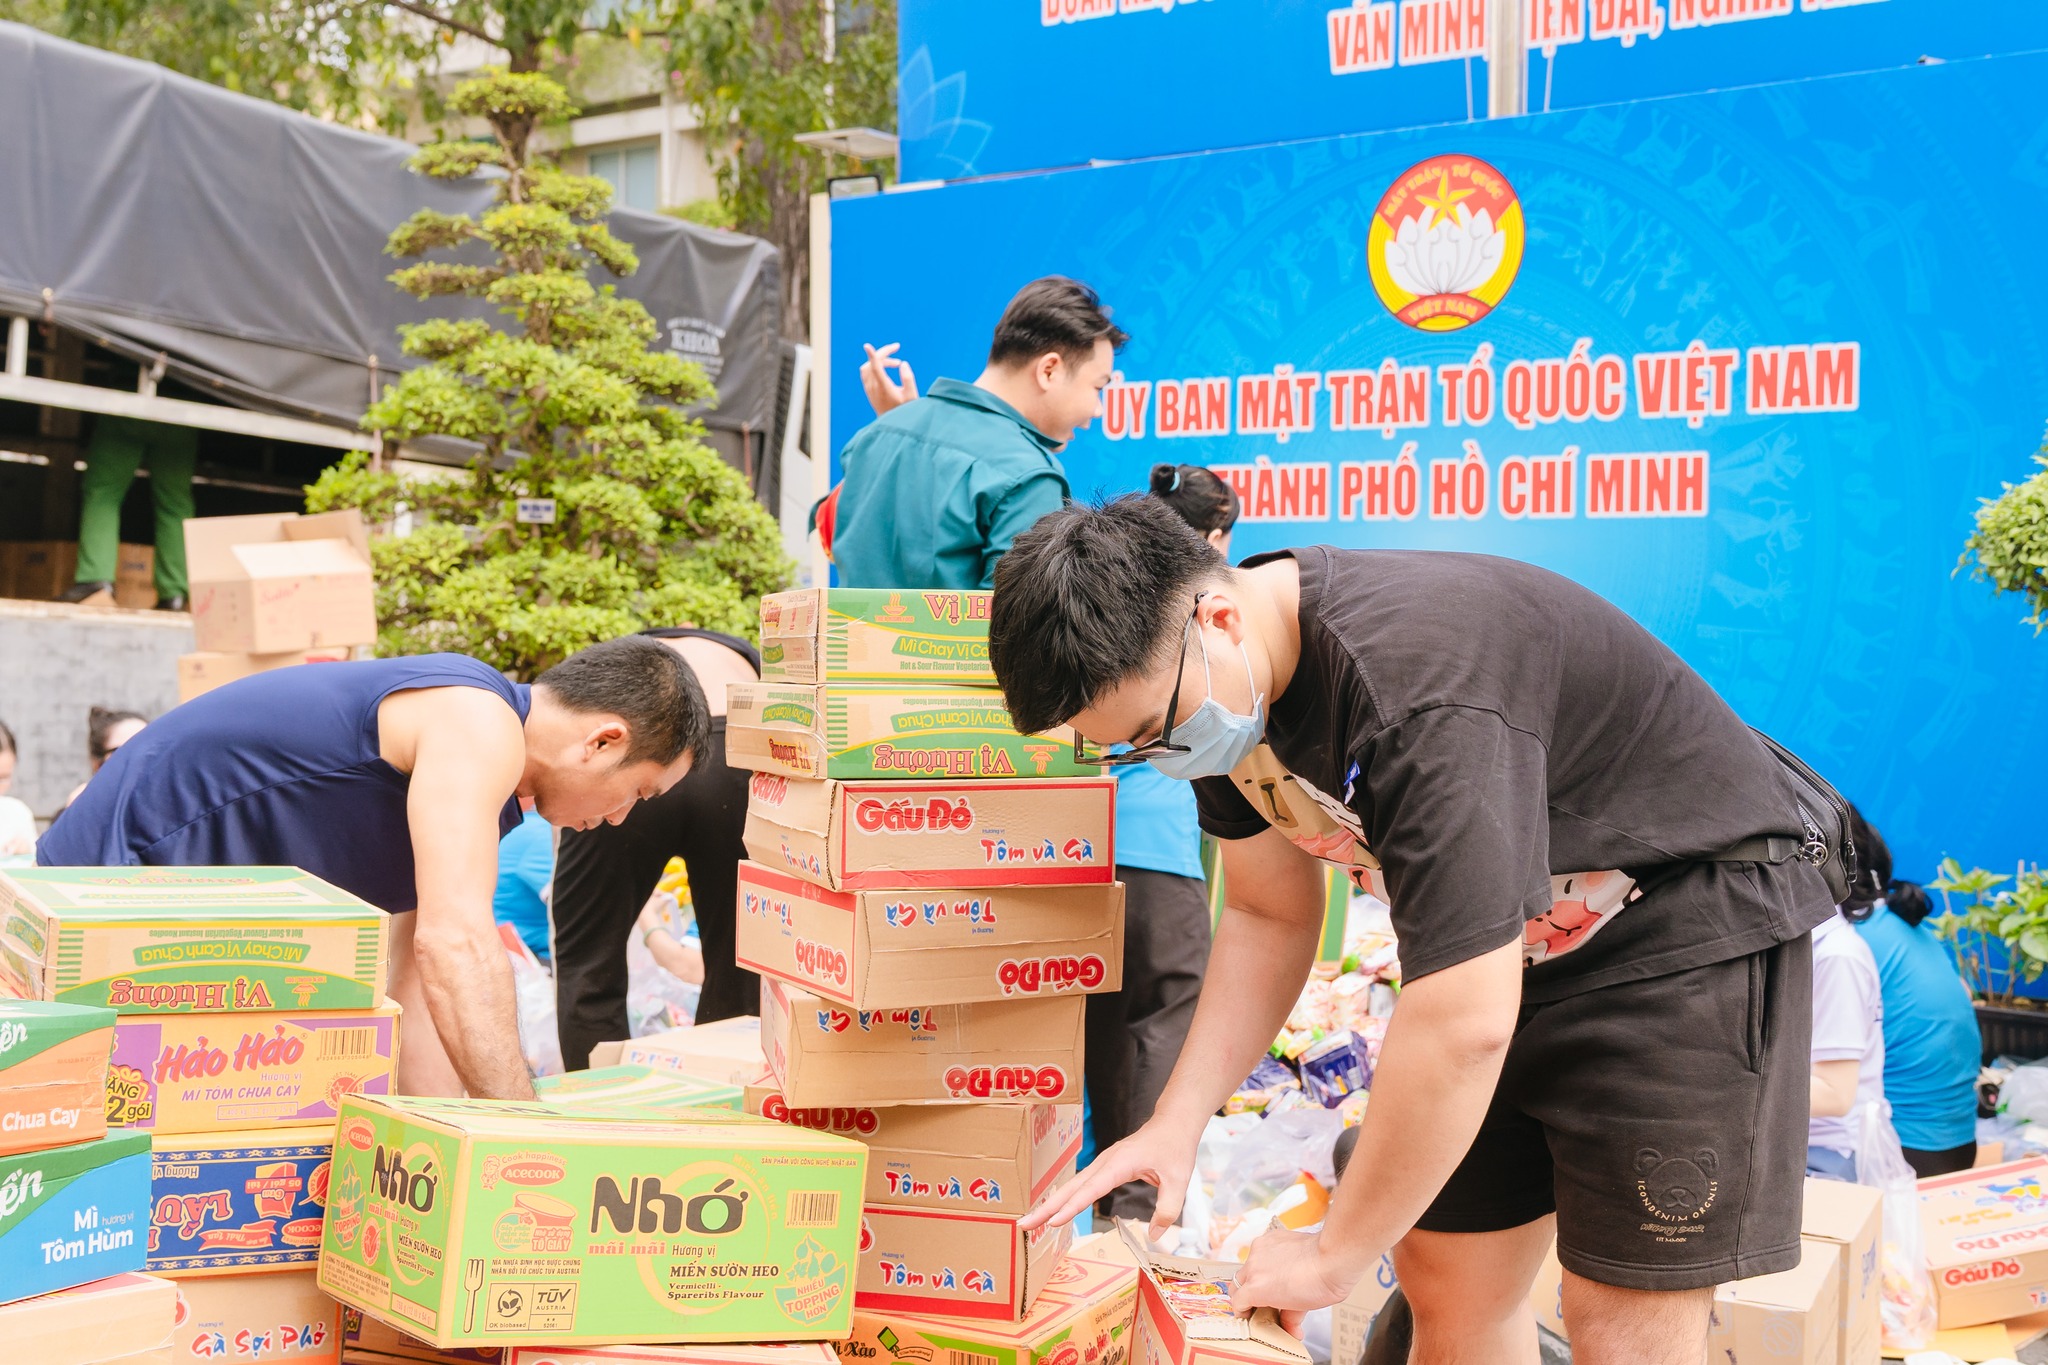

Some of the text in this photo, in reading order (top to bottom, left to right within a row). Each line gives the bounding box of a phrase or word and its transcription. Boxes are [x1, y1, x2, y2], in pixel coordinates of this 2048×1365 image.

[1105, 341, 1855, 438] ỦY BAN MẶT TRẬN TỔ QUỐC VIỆT NAM
[1342, 446, 1417, 518] PHỐ
[1432, 445, 1486, 517] HỒ
[1501, 451, 1573, 515] CHÍ
[1590, 456, 1704, 513] MINH
[923, 594, 960, 625] Vị
[899, 637, 918, 653] Mì
[917, 640, 956, 659] Chay
[899, 661, 911, 671] Hot
[917, 661, 933, 671] Sour
[932, 661, 956, 671] Flavour
[955, 662, 990, 672] Vegetarian
[897, 712, 935, 728] Chua
[935, 711, 971, 727] Canh
[874, 744, 1015, 776] Vị Hương
[855, 796, 974, 835] Gấu Đỏ
[980, 837, 1095, 864] Tôm và Gà
[885, 900, 997, 928] Tôm và Gà
[141, 941, 303, 962] Mì Chay Vị Canh Chua
[814, 943, 848, 987] Gấu
[998, 955, 1106, 995] Gấu Đỏ
[110, 978, 272, 1009] Vị Hương
[816, 1008, 939, 1032] Tôm và Gà
[154, 1025, 304, 1084] Hảo Hảo
[107, 1075, 139, 1099] ẶNG
[126, 1102, 150, 1120] gói
[205, 1087, 234, 1100] TÔM
[237, 1086, 272, 1099] CHUA
[276, 1084, 301, 1097] CAY
[944, 1067, 1065, 1099] Gấu Đỏ
[2, 1107, 81, 1132] Chua Cay
[166, 1164, 198, 1179] Hương
[370, 1144, 438, 1213] Nhớ
[885, 1171, 1001, 1202] Tôm và Gà
[1637, 1180, 1718, 1222] ICONDENIM ORGNLS
[74, 1209, 99, 1230] Mì
[102, 1215, 123, 1227] hương
[157, 1192, 230, 1238] LẨU
[590, 1176, 749, 1235] Nhớ
[41, 1226, 134, 1265] Tôm Hùm
[429, 1246, 443, 1260] HEO
[588, 1241, 665, 1255] mãi mãi
[671, 1244, 717, 1258] Hương vị
[669, 1260, 780, 1278] MIẾN SƯỜN HEO
[880, 1262, 996, 1295] Tôm và Gà
[667, 1290, 765, 1300] Spareribs Flavour
[669, 1282, 717, 1291] Vermicelli
[784, 1284, 841, 1315] TOPPING
[796, 1278, 825, 1297] NHIỀU
[806, 1302, 828, 1320] HƠN
[191, 1322, 327, 1359] Gà Sợi Phở
